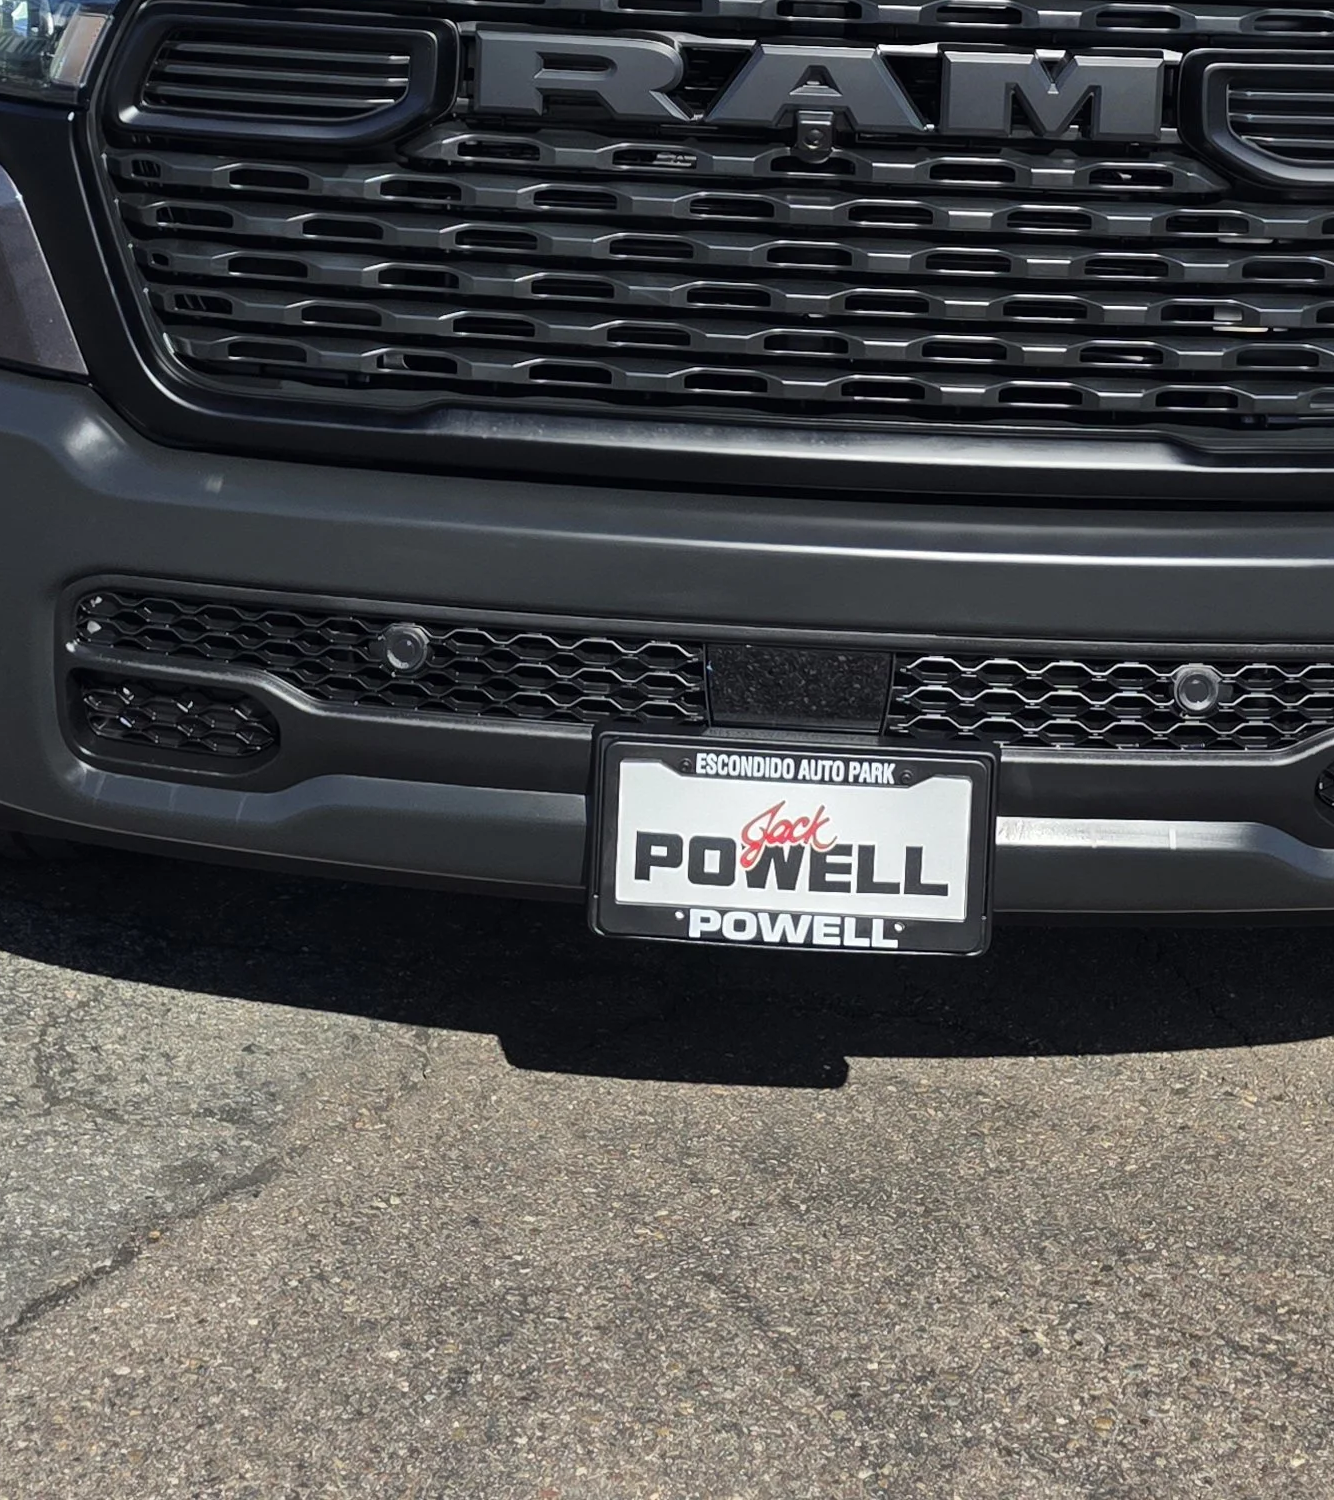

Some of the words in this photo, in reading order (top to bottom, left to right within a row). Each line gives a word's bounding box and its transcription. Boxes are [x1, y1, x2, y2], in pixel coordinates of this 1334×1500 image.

[474, 29, 1164, 142] RAM
[695, 753, 795, 780] ESCONDIDO
[797, 759, 845, 782] AUTO
[848, 761, 896, 785] PARK
[634, 830, 950, 897] POWELL
[741, 800, 838, 870] Jack
[688, 908, 899, 949] POWELL
